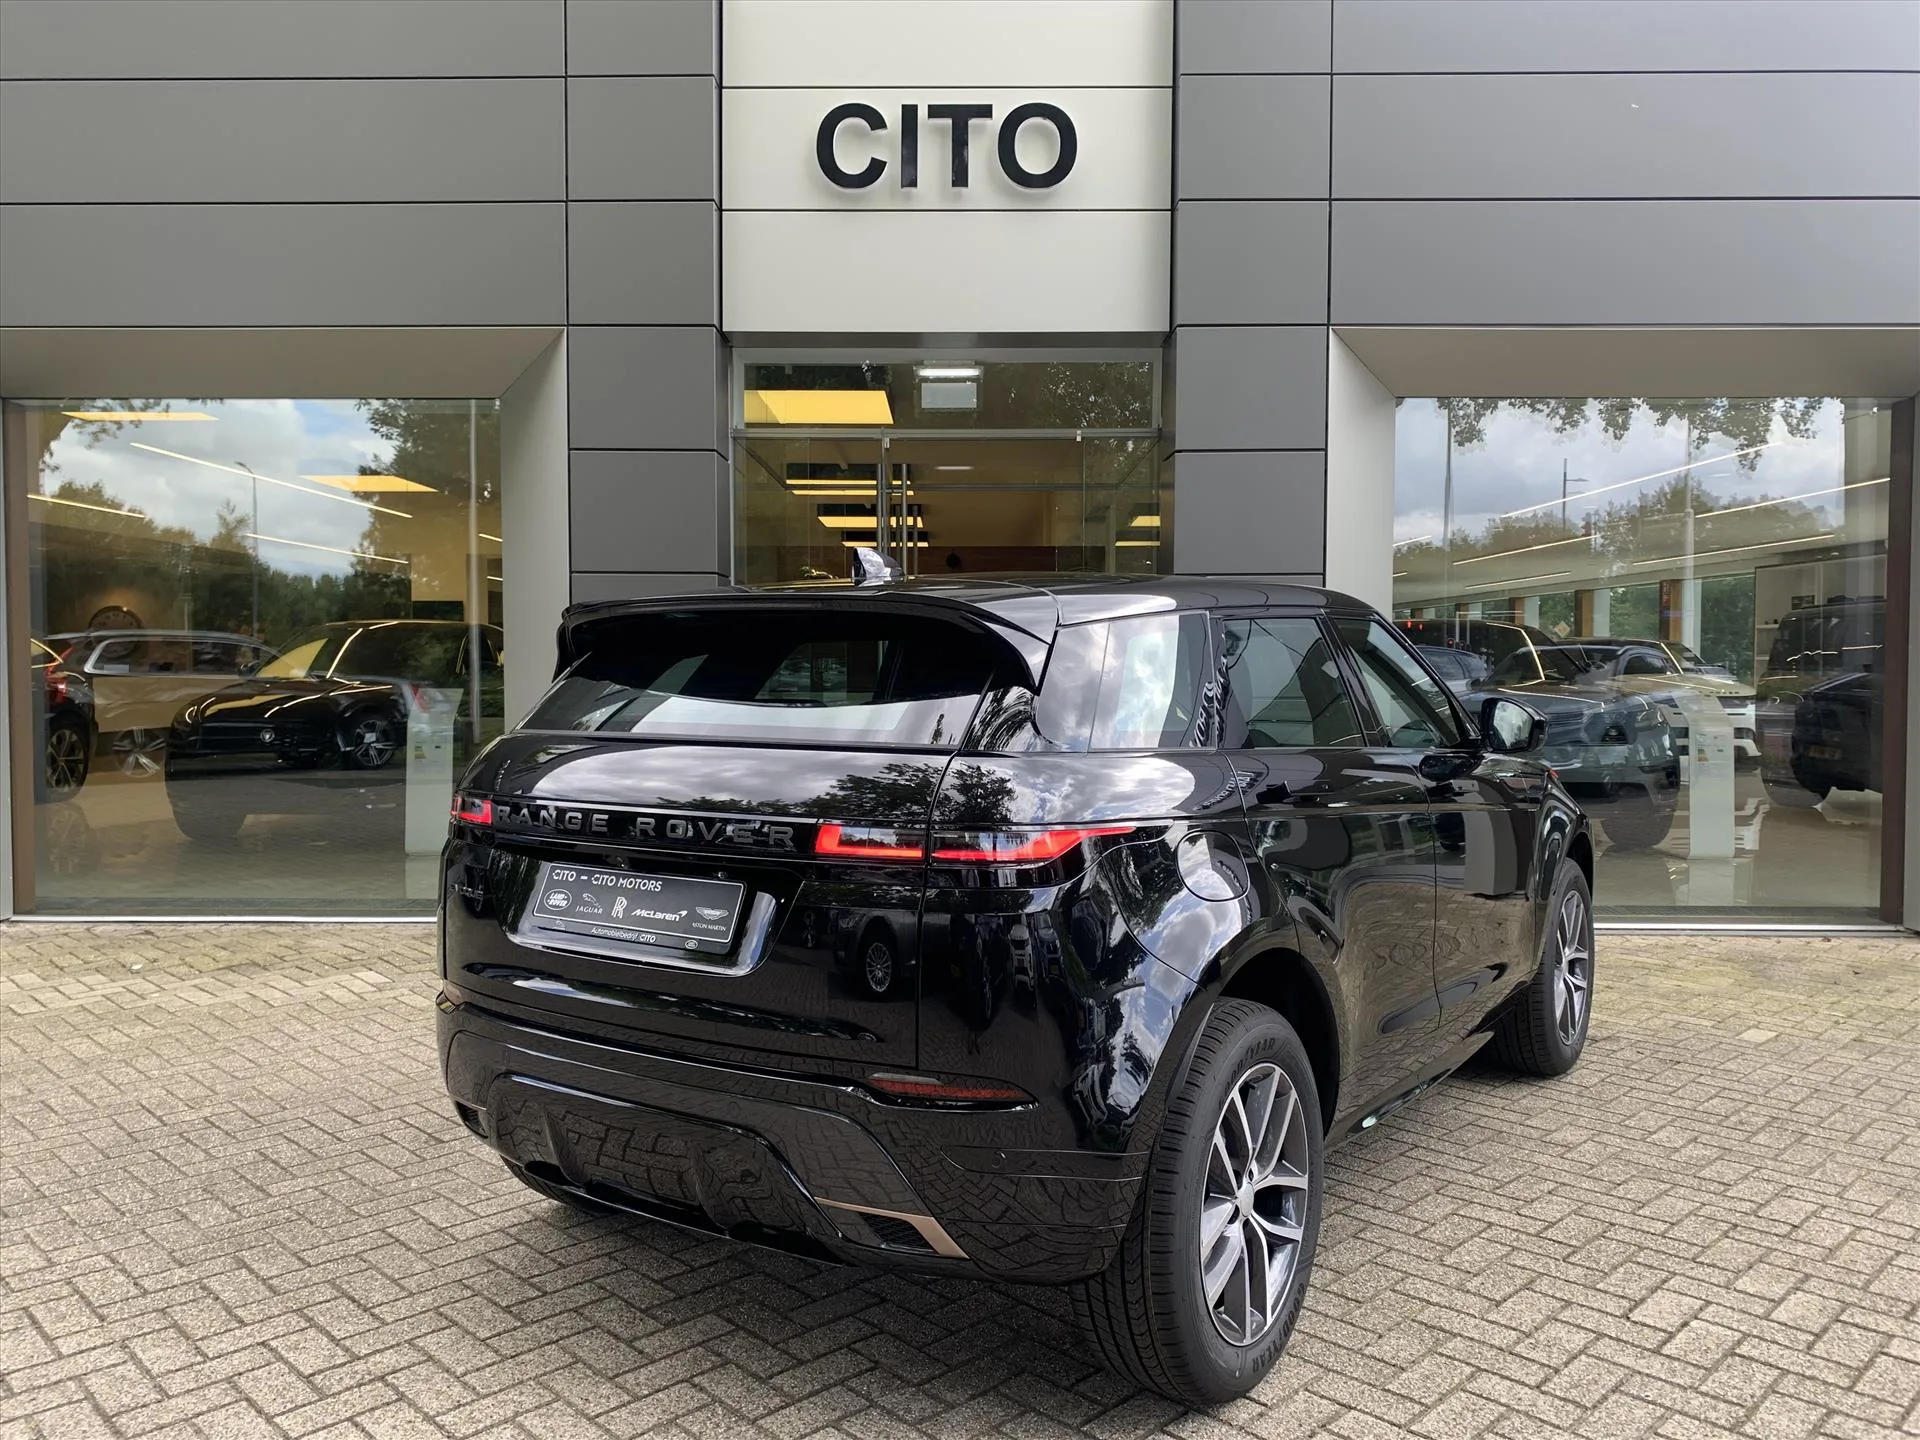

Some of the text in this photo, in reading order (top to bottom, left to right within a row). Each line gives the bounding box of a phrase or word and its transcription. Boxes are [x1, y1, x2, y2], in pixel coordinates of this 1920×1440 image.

[816, 102, 1078, 189] CITO
[499, 804, 796, 847] RANGE ROVER
[552, 869, 576, 882] CITO
[591, 874, 616, 887] CITO
[618, 877, 663, 892] MOTORS
[575, 905, 603, 914] JAGUAR
[631, 908, 680, 922] McLaren
[639, 934, 656, 943] CITO
